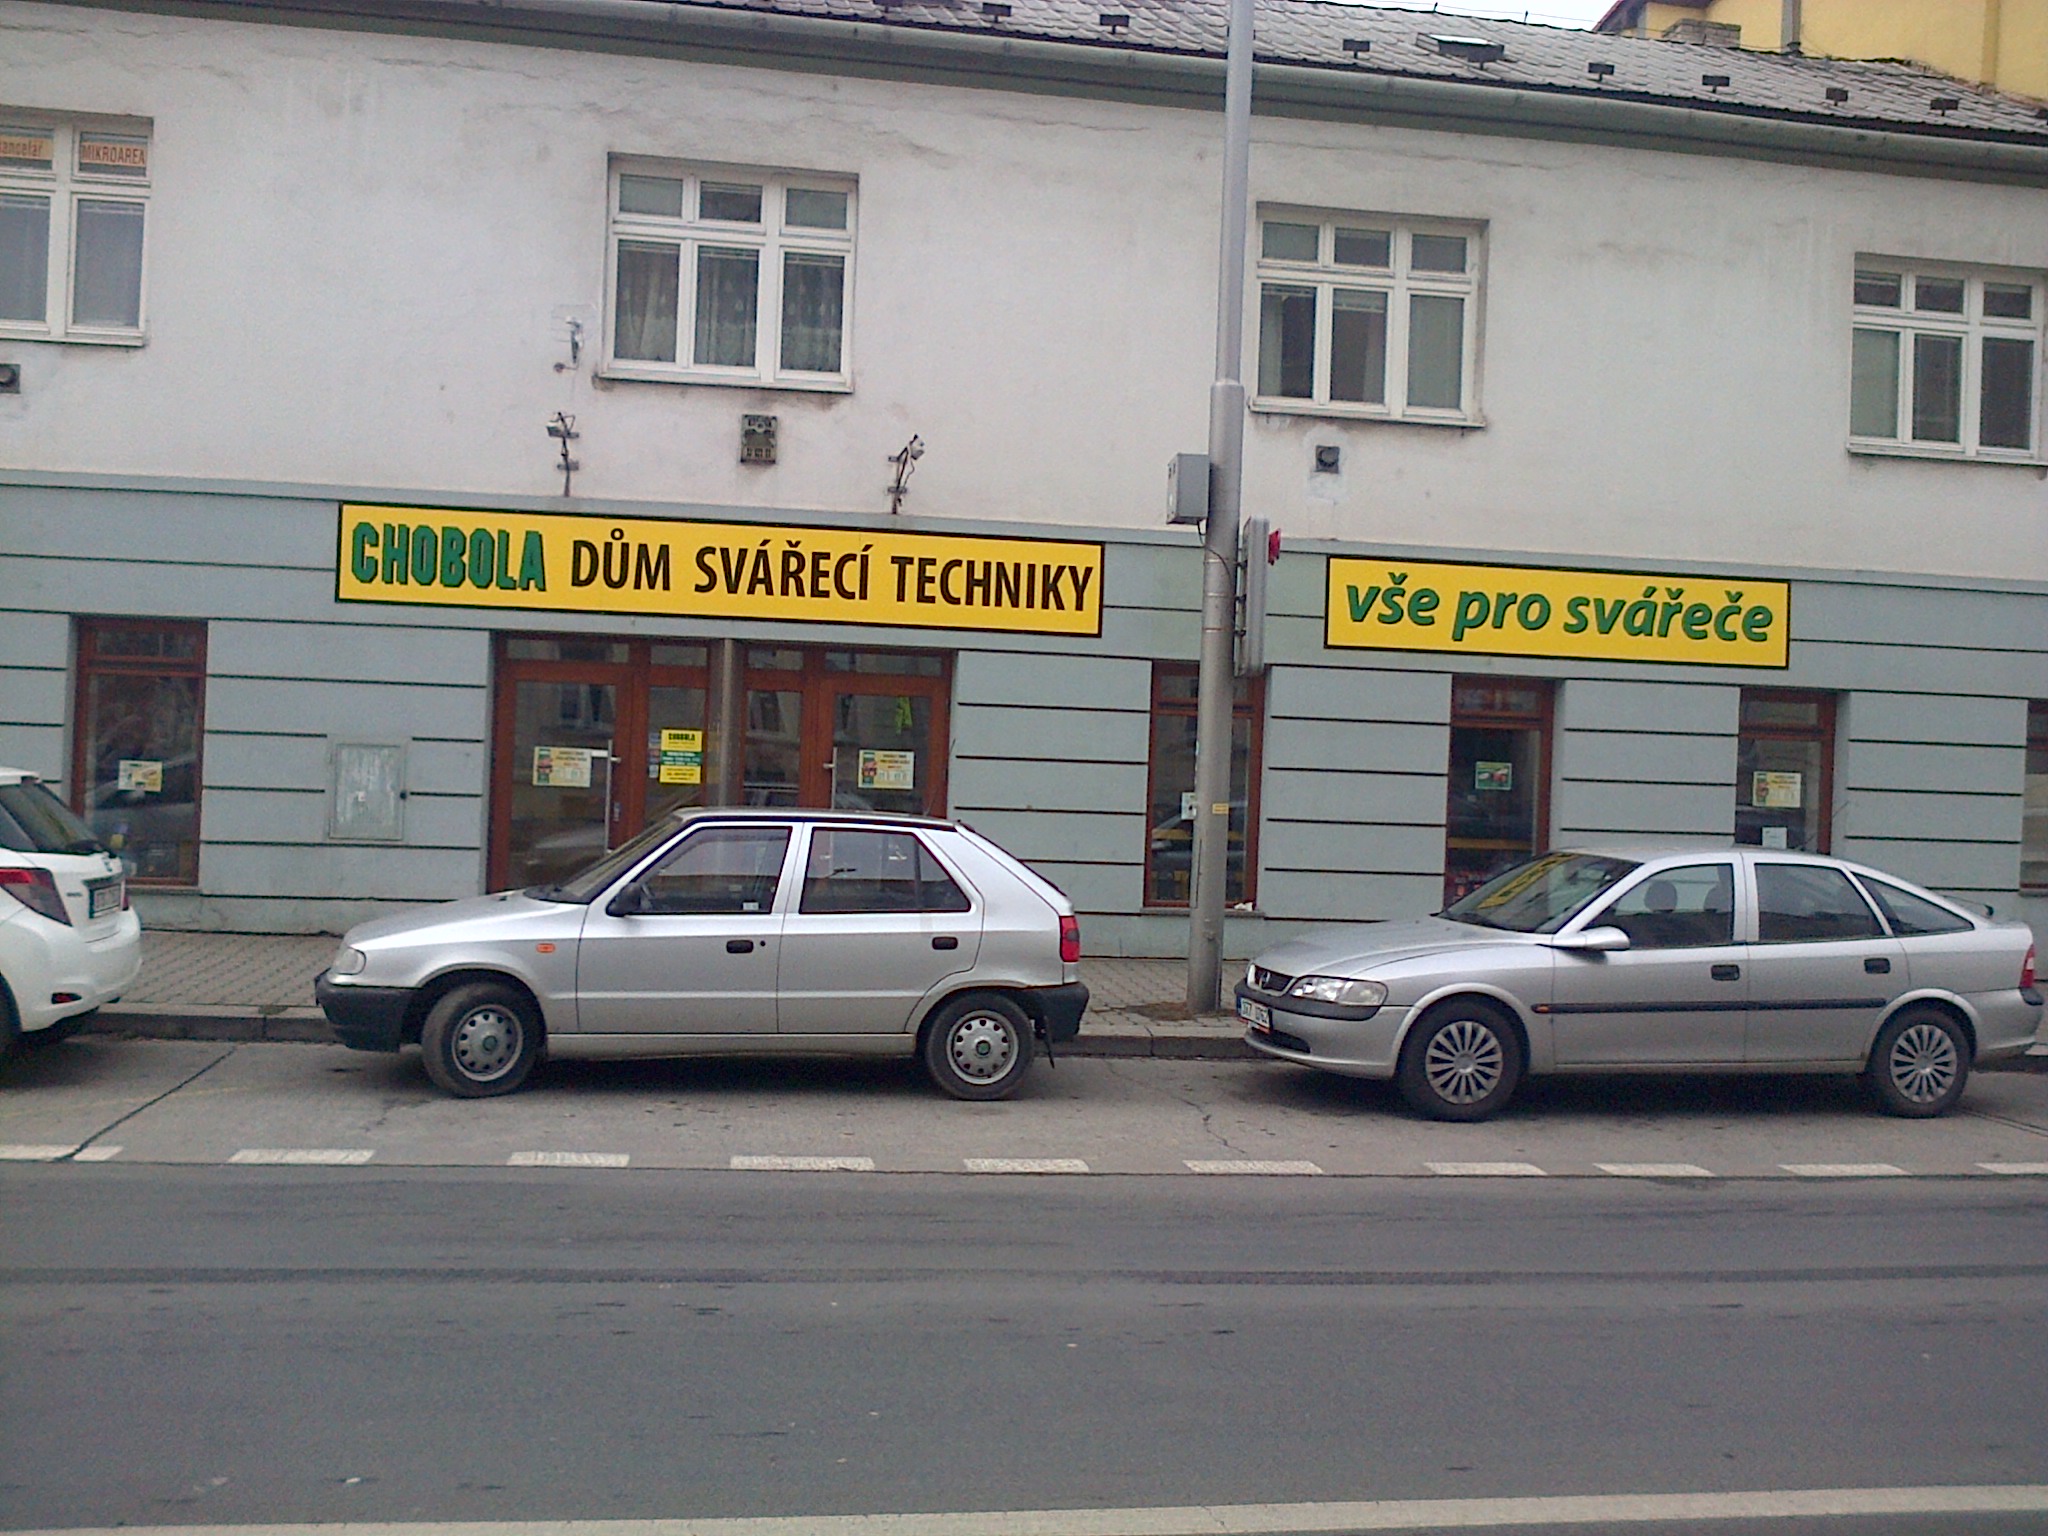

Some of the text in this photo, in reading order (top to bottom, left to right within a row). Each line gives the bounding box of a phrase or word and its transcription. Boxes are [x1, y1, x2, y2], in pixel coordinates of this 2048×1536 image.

[81, 143, 146, 164] MIKROAREA
[351, 522, 1093, 612] CHOBOLA DŮM SVÁŘECÍ TECHNIKY
[1346, 572, 1773, 641] vše pro svářeče
